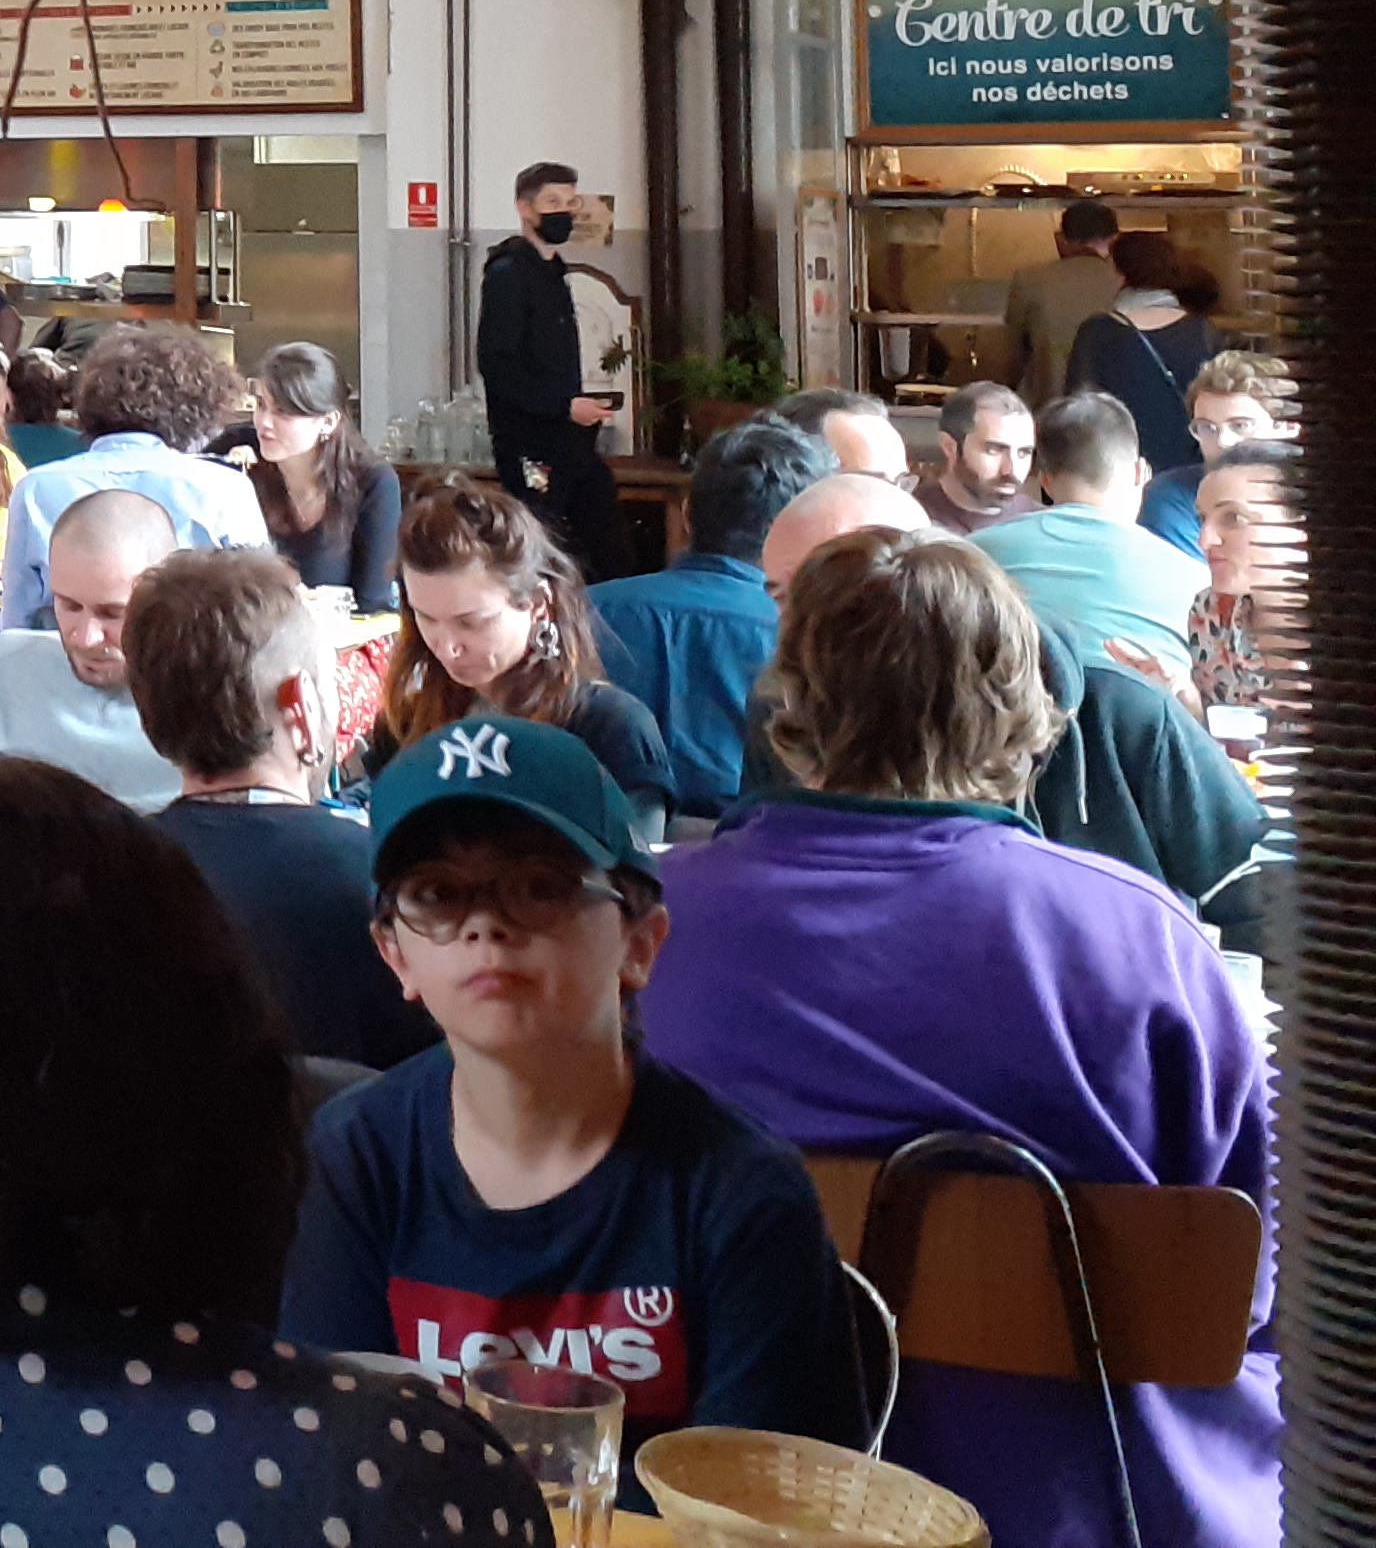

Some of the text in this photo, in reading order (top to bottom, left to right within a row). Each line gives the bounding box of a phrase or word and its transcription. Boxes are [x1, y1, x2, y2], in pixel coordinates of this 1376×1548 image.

[928, 53, 1174, 76] Ici nous valorisons
[972, 80, 1129, 103] nos déchets
[438, 723, 511, 780] NY
